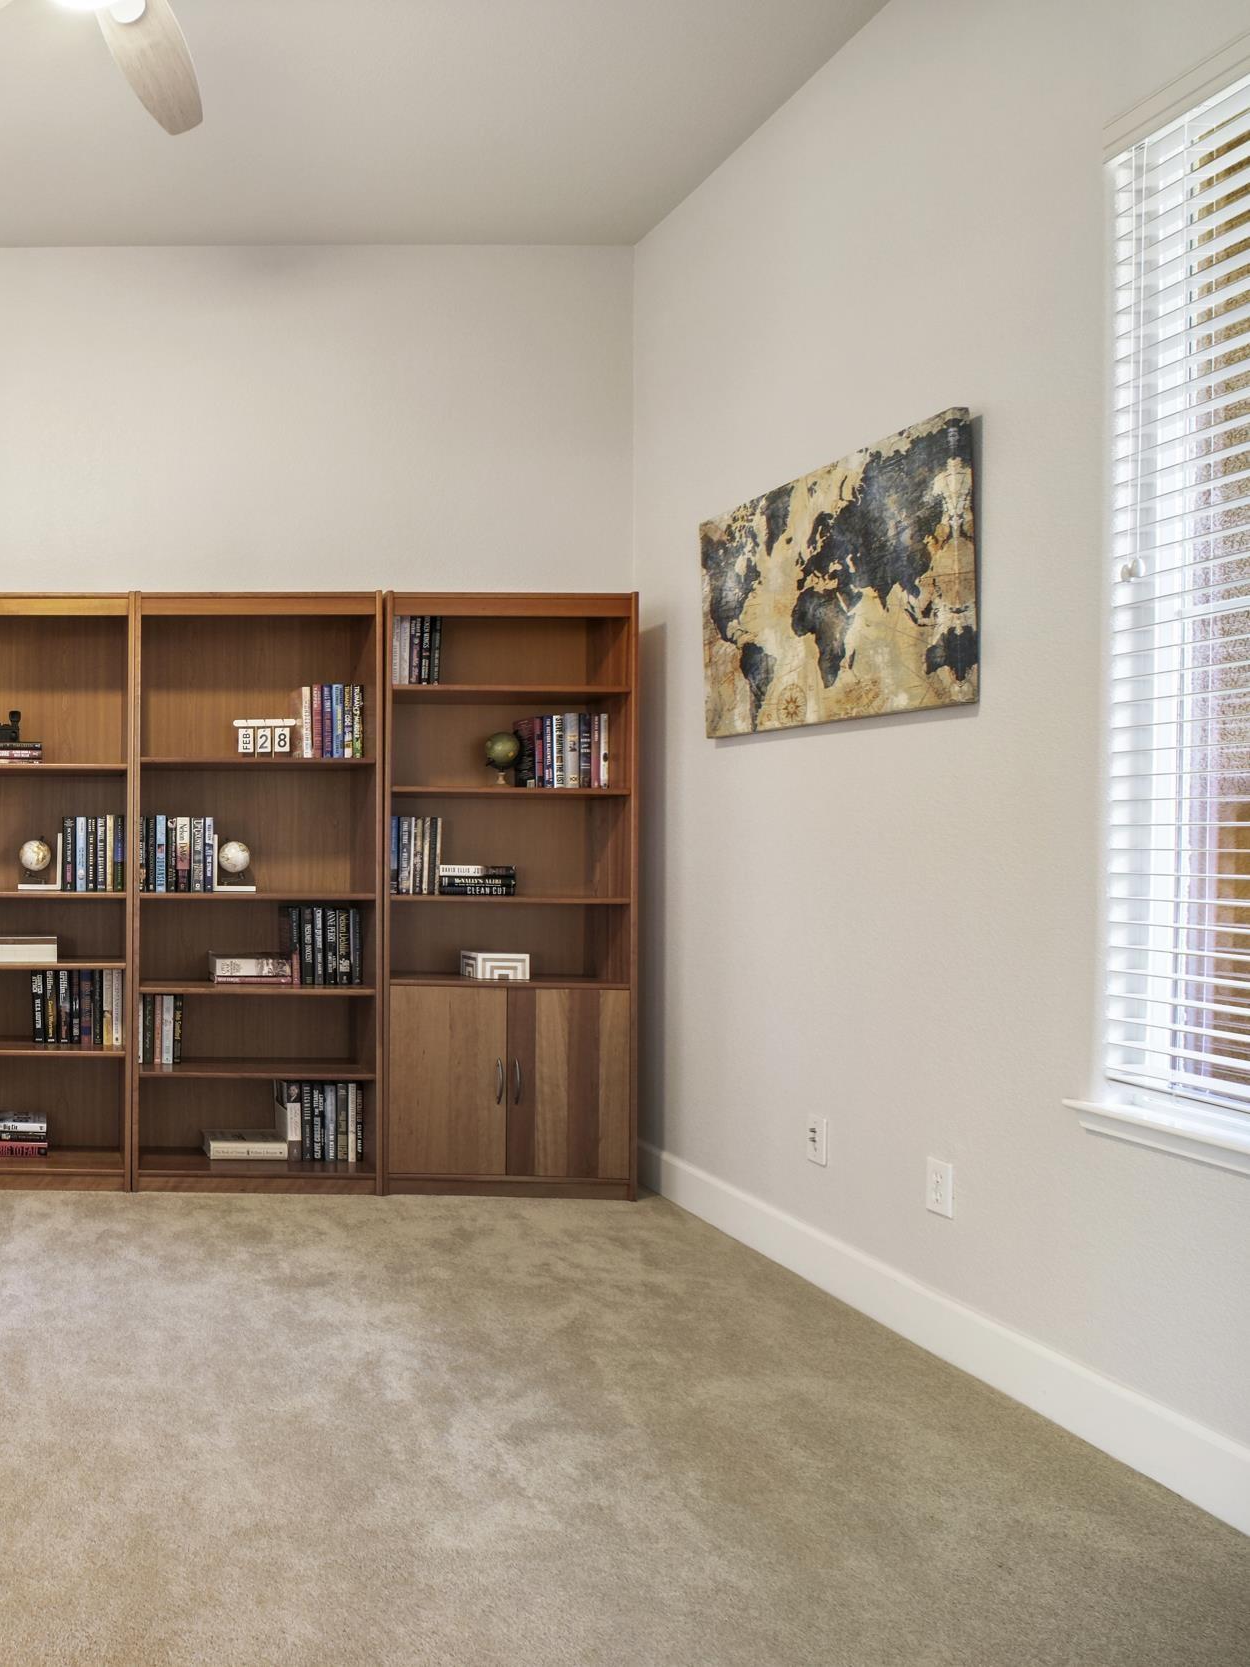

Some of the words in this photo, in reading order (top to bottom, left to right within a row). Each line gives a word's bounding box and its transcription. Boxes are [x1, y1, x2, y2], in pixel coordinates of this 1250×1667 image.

[556, 718, 564, 734] STEVE
[242, 733, 251, 751] FEB
[556, 764, 564, 774] THE
[556, 774, 564, 786] LIST
[178, 824, 188, 841] Nelson
[467, 887, 490, 895] CLEAN
[492, 887, 507, 895] CUT
[327, 911, 336, 926] ANNE
[340, 913, 350, 932] Nelson
[327, 927, 336, 943] PERRY
[340, 933, 350, 956] DeMille
[46, 970, 54, 990] Griffin
[59, 970, 68, 994] Griffin
